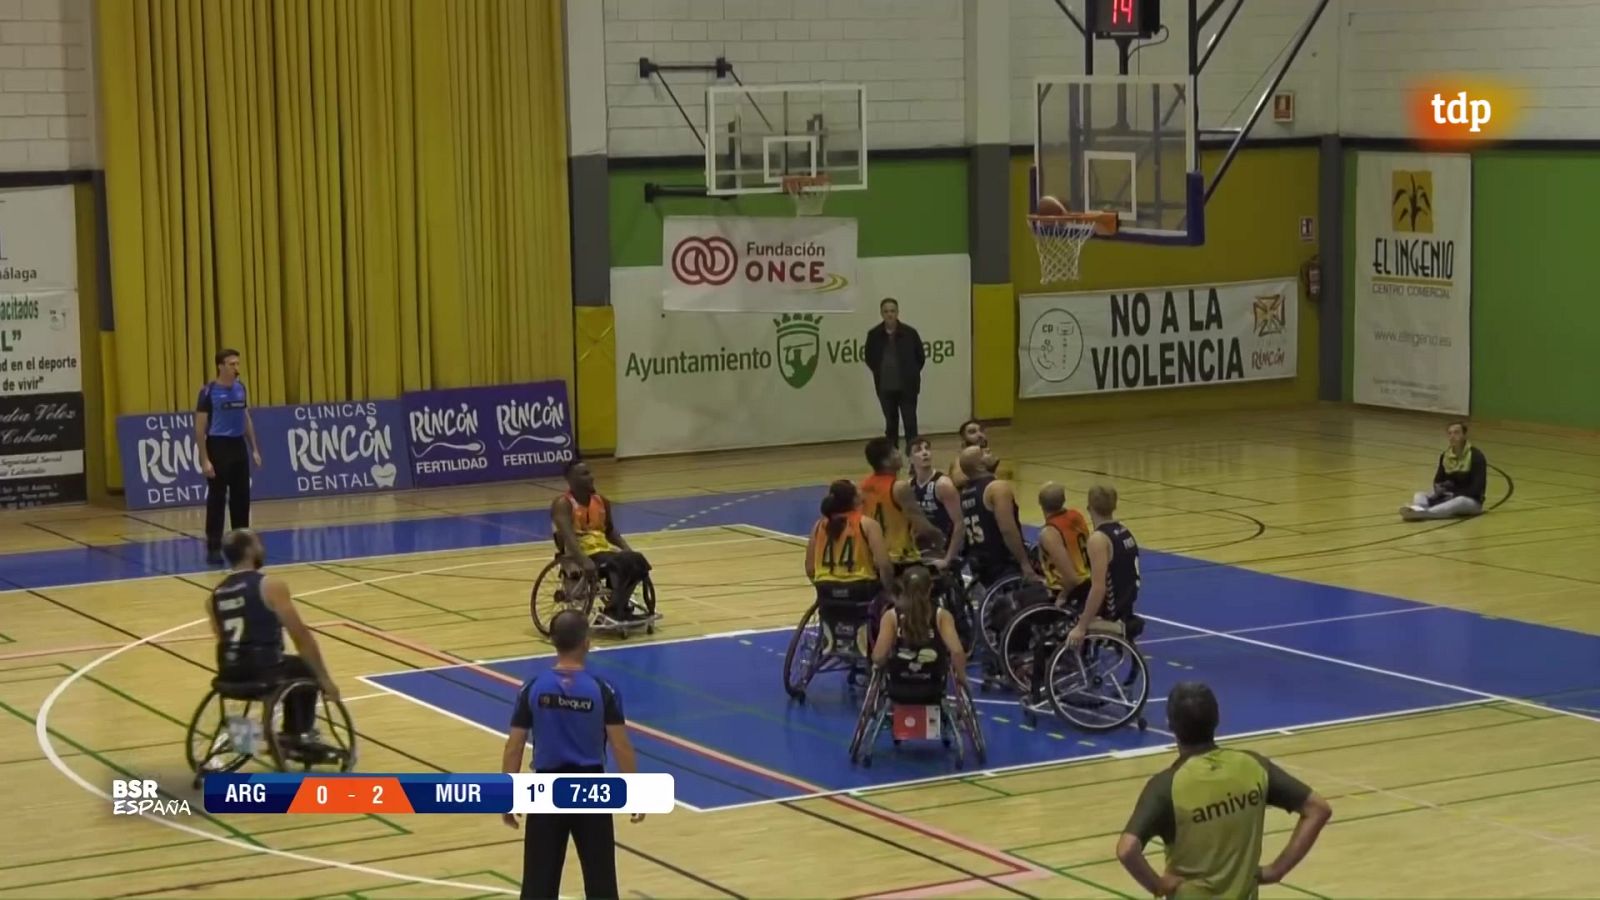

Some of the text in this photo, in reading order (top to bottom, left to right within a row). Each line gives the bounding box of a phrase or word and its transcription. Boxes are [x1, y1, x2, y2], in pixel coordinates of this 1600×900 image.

[746, 241, 825, 256] Fundación
[1372, 237, 1454, 279] EL INGENIO
[745, 260, 825, 283] ONCE
[1110, 288, 1223, 338] NO A LA
[11, 361, 23, 371] en
[26, 357, 36, 370] el
[38, 356, 77, 372] deporte
[625, 346, 772, 382] Ayuntamiento
[1090, 336, 1245, 391] VIOLENCIA
[2, 378, 15, 391] de
[294, 402, 377, 420] CLINICAS
[146, 414, 194, 431] CLINI
[416, 457, 488, 474] FERTILIDAD
[503, 449, 573, 466] FERTILIDAD
[297, 472, 375, 491] DENTAL
[224, 616, 245, 648] 7
[1192, 782, 1263, 823] amivel
